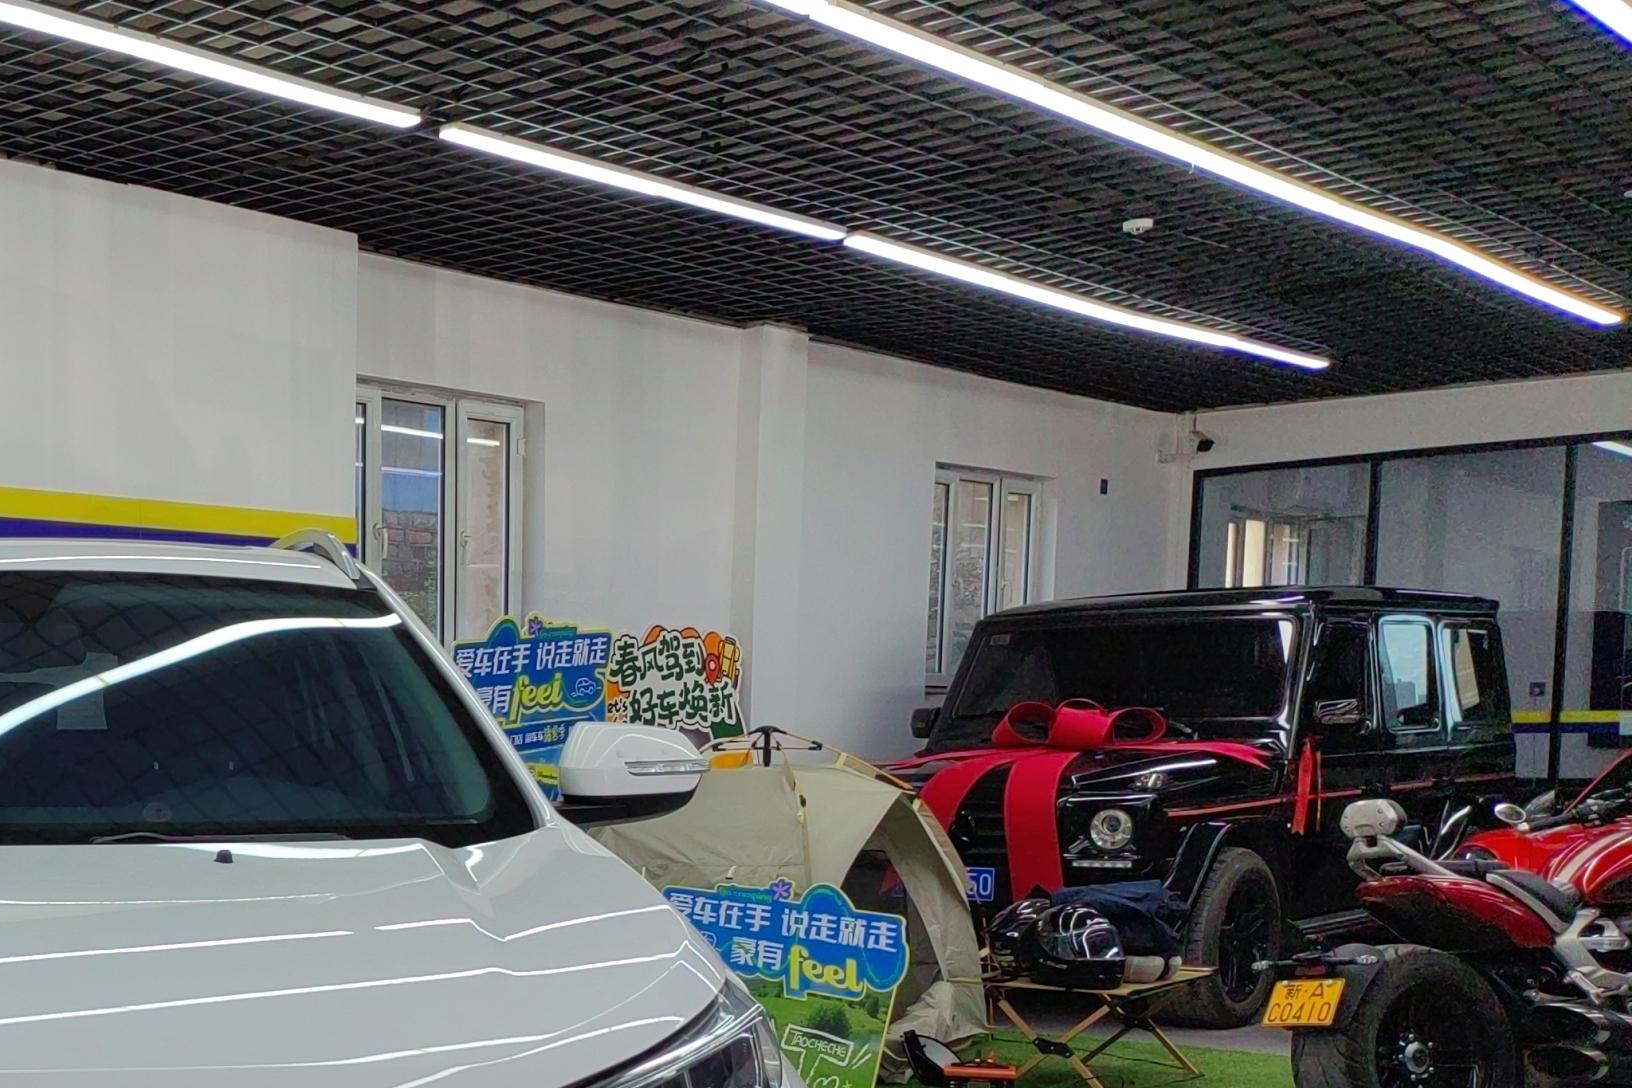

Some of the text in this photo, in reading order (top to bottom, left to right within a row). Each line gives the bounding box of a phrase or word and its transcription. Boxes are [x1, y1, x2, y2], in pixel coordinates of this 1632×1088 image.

[456, 637, 608, 678] 爱车在手 说走就走
[609, 635, 705, 687] 春风驾到
[509, 672, 563, 724] feel
[607, 680, 734, 726] et's 好车焕新
[670, 892, 898, 953] 爱车在手 说走就走
[788, 945, 864, 993] feel
[789, 1029, 847, 1058] TAOCHECHE
